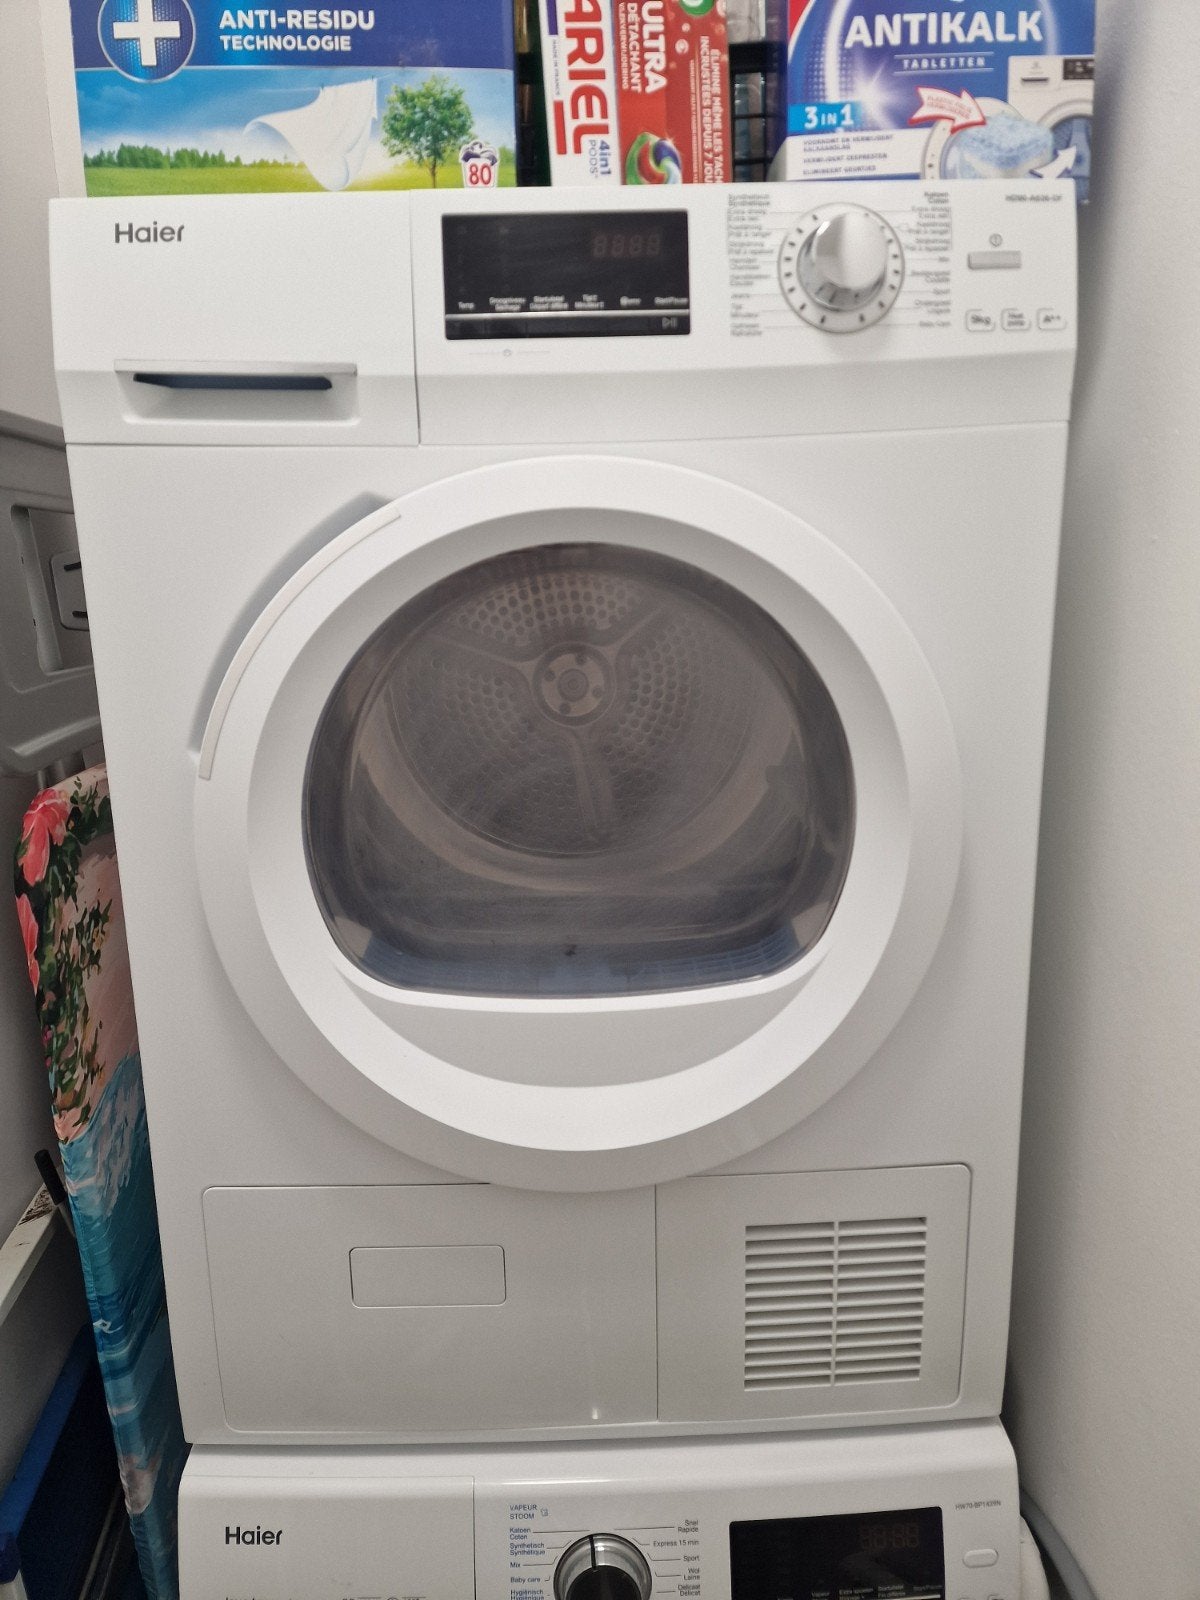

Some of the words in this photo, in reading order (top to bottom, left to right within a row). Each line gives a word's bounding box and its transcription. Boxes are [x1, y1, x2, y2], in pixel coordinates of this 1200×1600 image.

[219, 9, 375, 30] ANTI-RESIDU
[844, 10, 1044, 48] ANTIKALK
[219, 34, 352, 51] TECHNOLOGIE
[626, 2, 643, 93] DÉTACHANT
[642, 0, 668, 93] ULTRA
[710, 48, 722, 94] ÉLIMINE
[903, 56, 986, 70] TABLETTEN
[711, 95, 724, 129] MÊME
[804, 105, 819, 129] 3
[821, 112, 837, 126] IN
[840, 103, 854, 126] 1
[702, 108, 713, 149] DEPUIS
[713, 131, 723, 152] LES
[598, 139, 612, 176] 4in1
[703, 151, 713, 159] 7
[469, 163, 491, 185] 80
[114, 220, 185, 244] Haier
[225, 1525, 283, 1545] Haier
[510, 1576, 526, 1584] Baby
